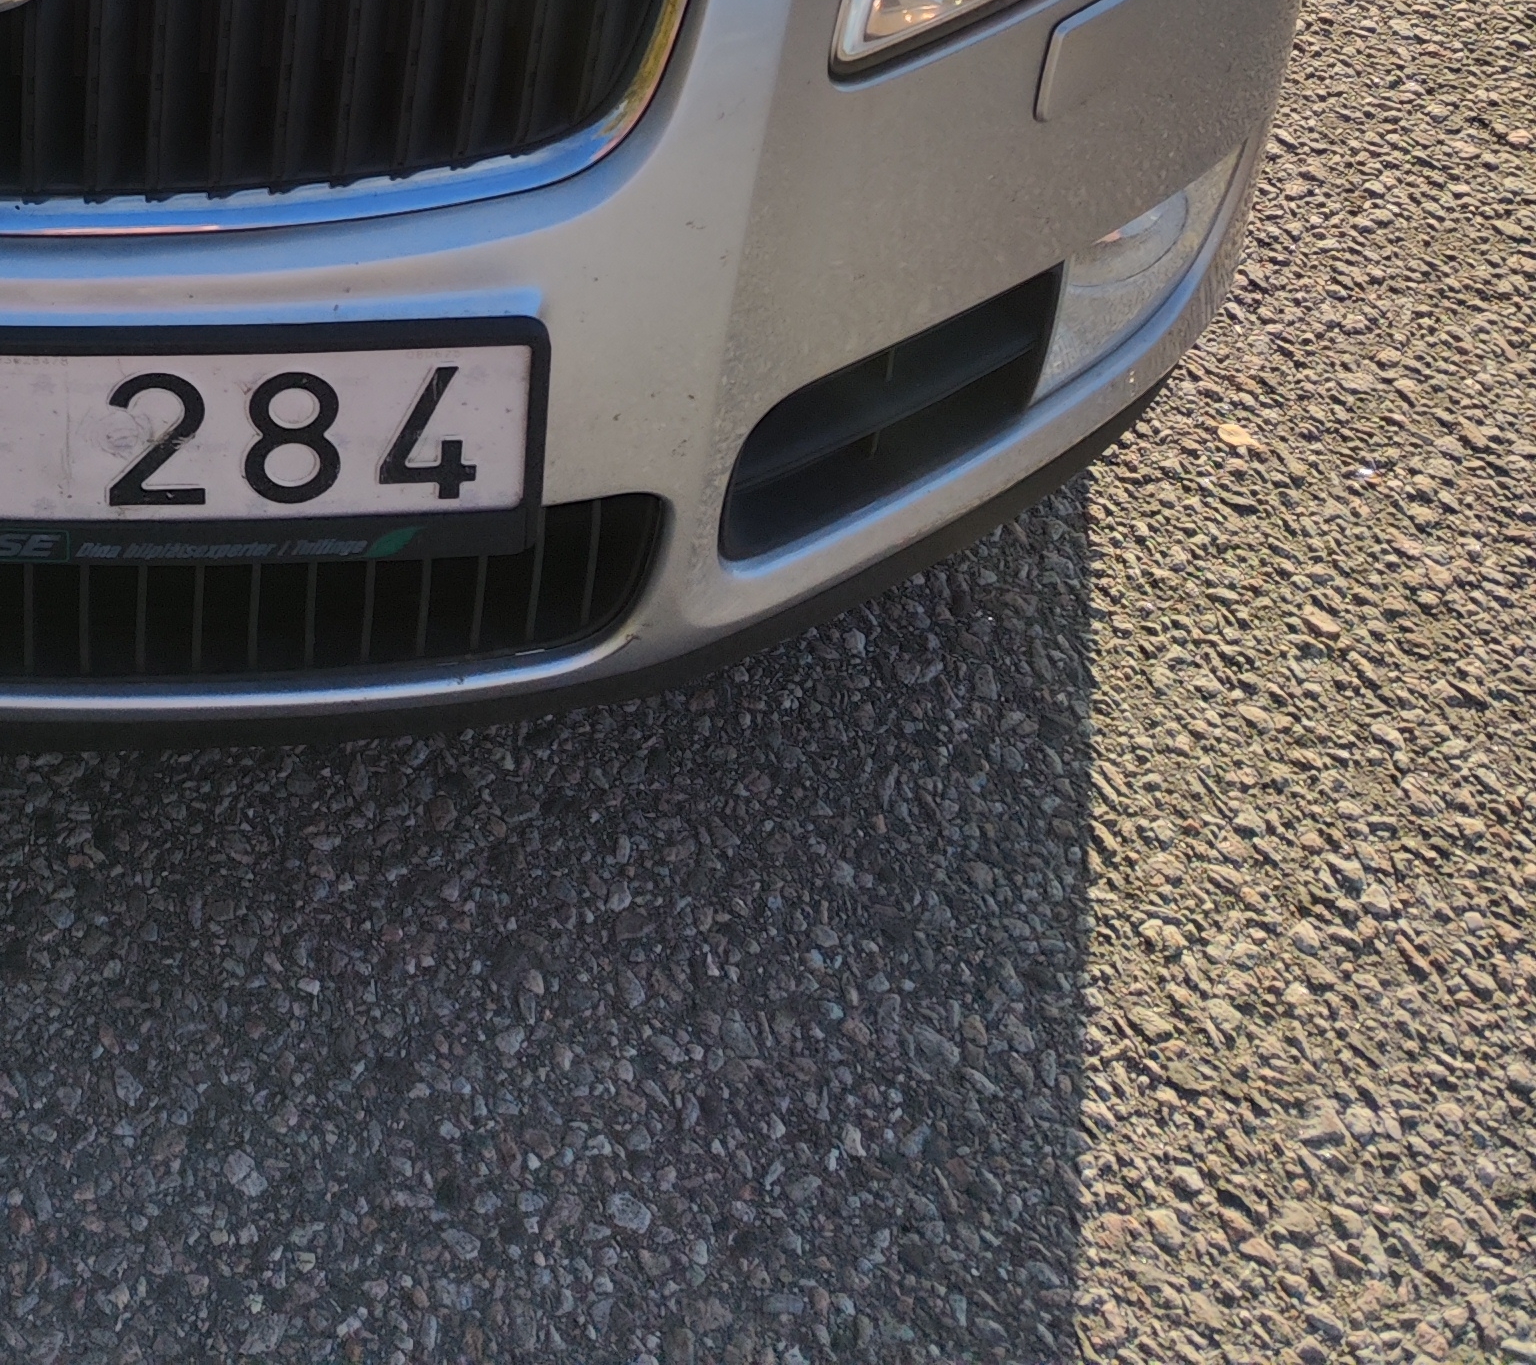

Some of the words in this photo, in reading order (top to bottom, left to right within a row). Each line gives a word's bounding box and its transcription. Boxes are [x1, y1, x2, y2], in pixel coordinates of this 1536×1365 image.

[108, 365, 477, 507] 284
[75, 541, 123, 558] Dina
[290, 538, 368, 556] Tullinge
